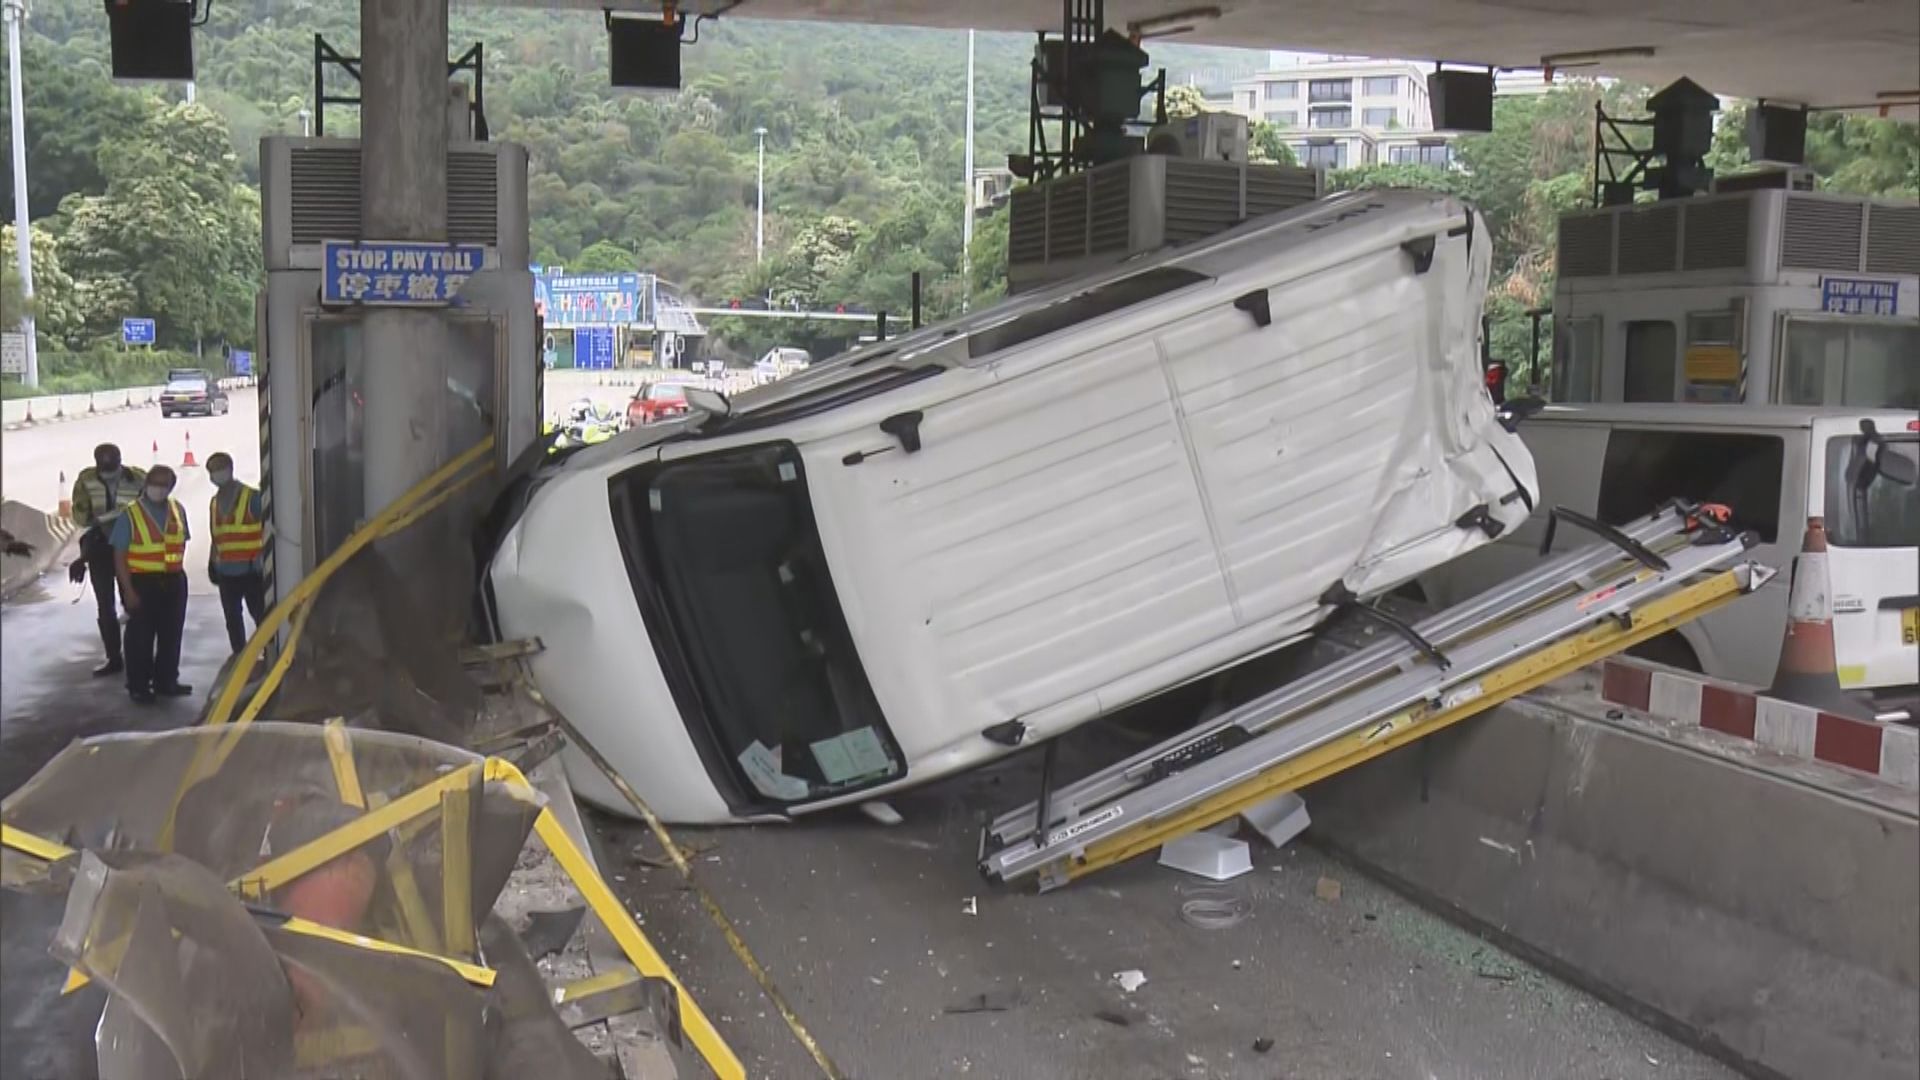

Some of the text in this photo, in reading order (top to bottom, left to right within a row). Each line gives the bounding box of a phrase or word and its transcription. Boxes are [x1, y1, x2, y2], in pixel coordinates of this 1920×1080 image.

[336, 249, 473, 271] STOP, PAY TOLL
